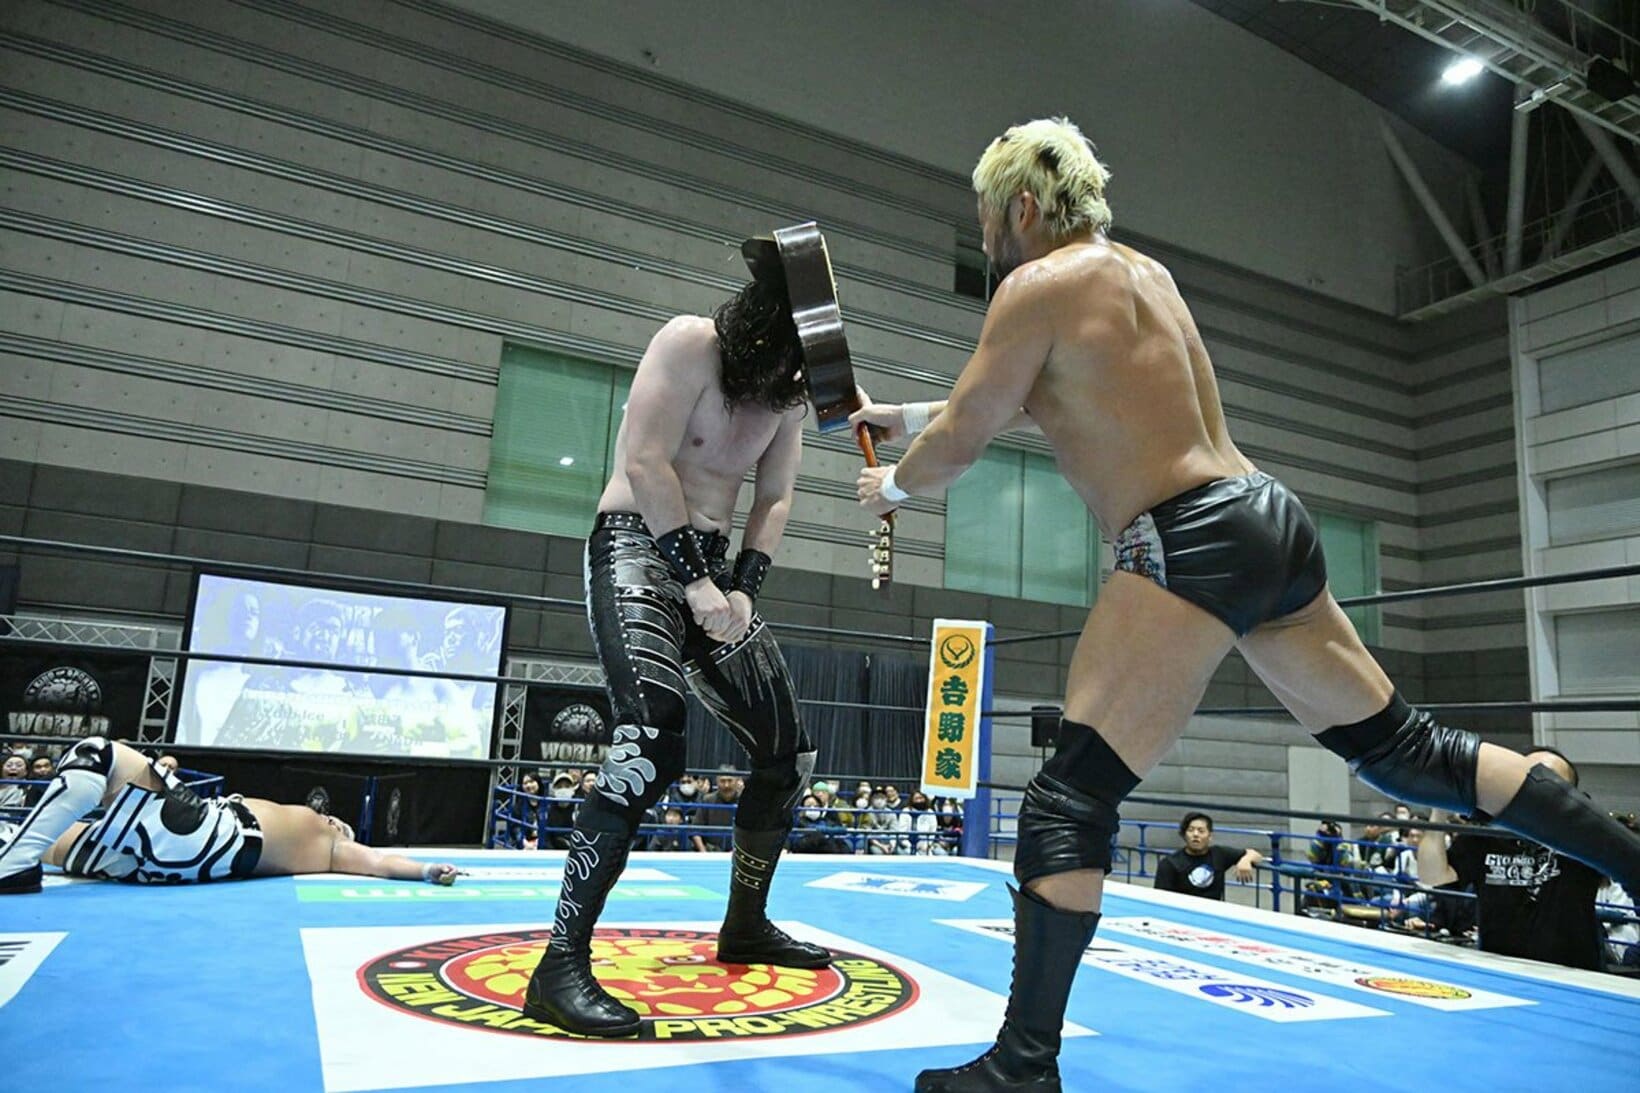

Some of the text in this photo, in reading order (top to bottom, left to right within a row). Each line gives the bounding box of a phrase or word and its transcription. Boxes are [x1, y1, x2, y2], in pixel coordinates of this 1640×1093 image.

[8, 711, 110, 736] WORLD
[934, 674, 969, 780] 吉野家
[402, 935, 522, 960] KING
[376, 972, 468, 1007] NEW
[654, 959, 902, 1039] PRO-WRESTLING
